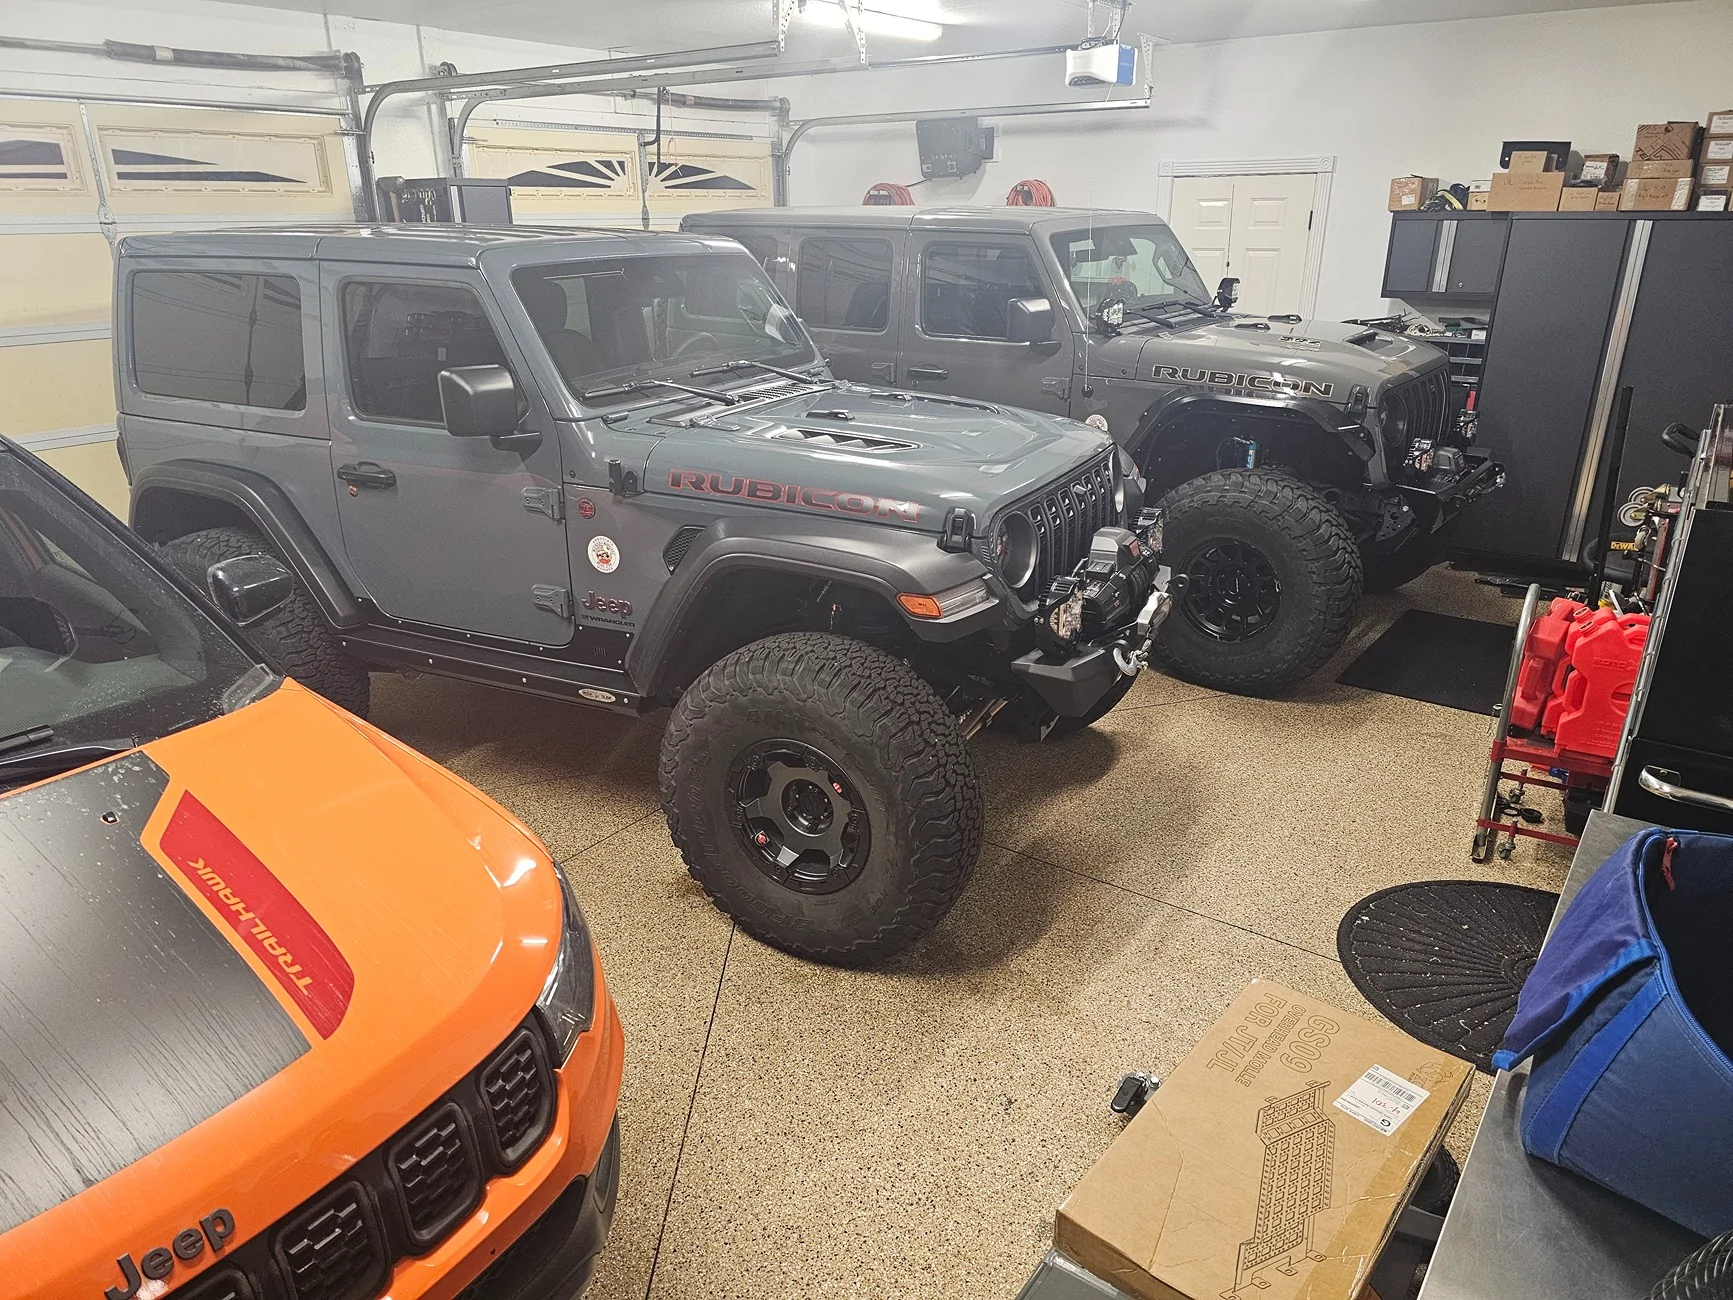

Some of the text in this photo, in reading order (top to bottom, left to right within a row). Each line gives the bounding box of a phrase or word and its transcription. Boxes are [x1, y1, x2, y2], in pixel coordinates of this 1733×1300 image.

[1152, 364, 1334, 397] RUBICON
[668, 468, 921, 523] RUBICON
[581, 590, 633, 619] Jeep
[589, 615, 636, 628] WRANGLER
[187, 857, 313, 997] TRAILHAWK
[1205, 992, 1287, 1073] FOR JT/JL
[1234, 1004, 1306, 1087] OVERHEAD MOLLE
[1279, 1014, 1340, 1074] GS09
[1380, 1118, 1391, 1128] G
[104, 1208, 236, 1300] Jeep
